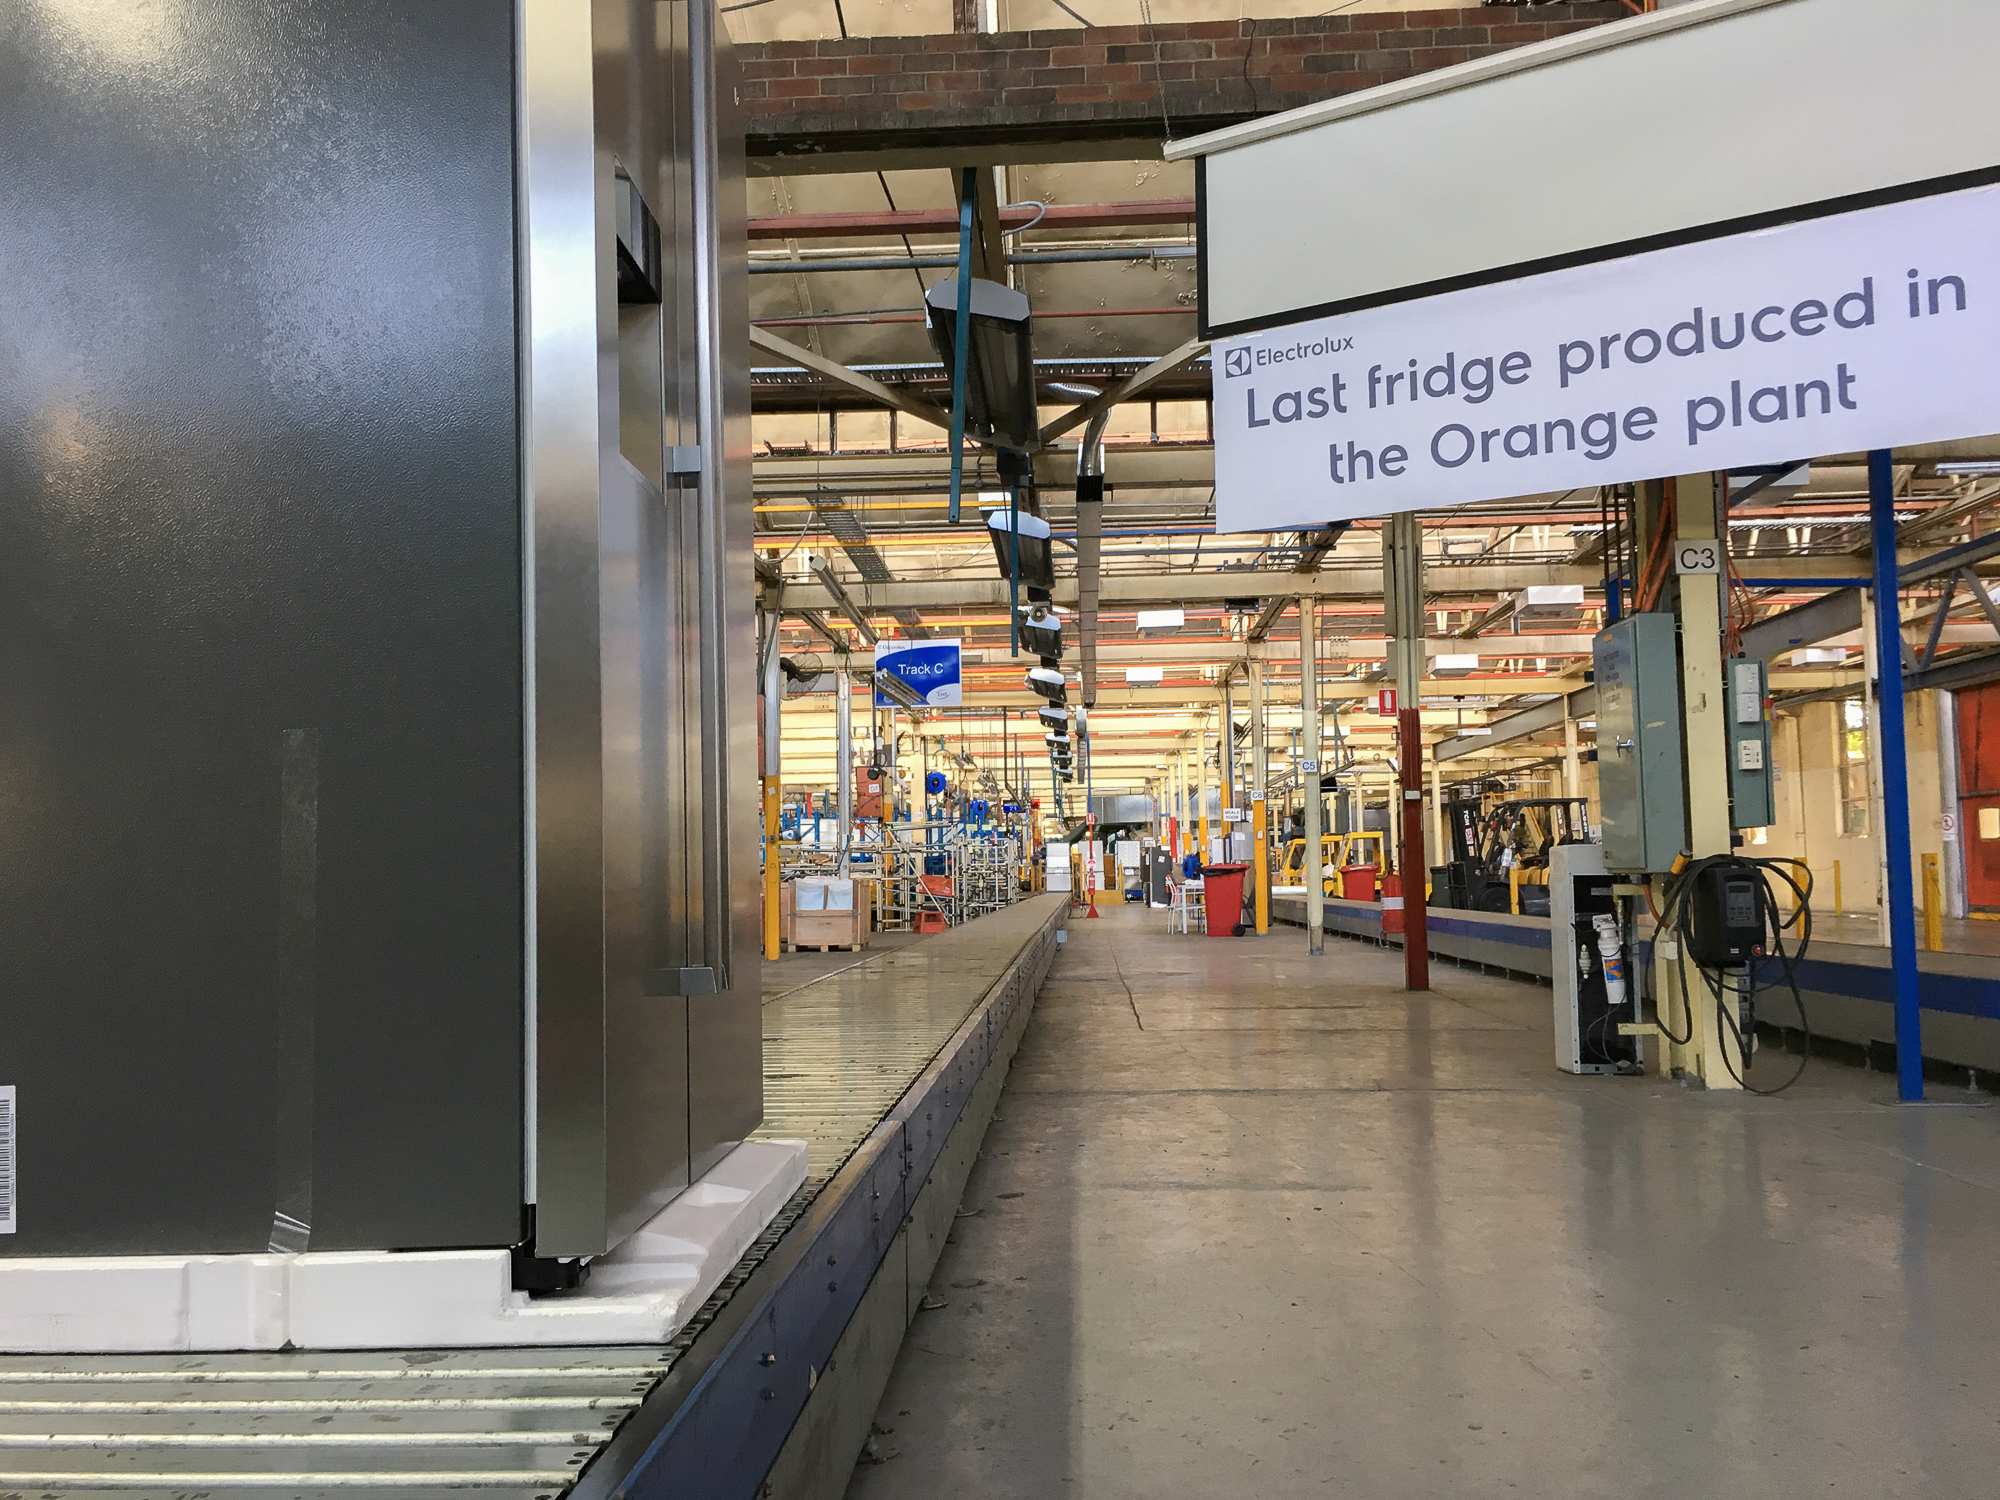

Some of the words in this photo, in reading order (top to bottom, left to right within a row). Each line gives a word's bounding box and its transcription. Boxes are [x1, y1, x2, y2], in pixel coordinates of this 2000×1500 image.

[1247, 372, 1348, 429] Last
[1367, 351, 1532, 410] fridge
[1558, 276, 1875, 389] produced
[1906, 268, 1967, 319] in
[1256, 336, 1355, 367] Electrolux
[1329, 440, 1409, 485] the
[1430, 406, 1658, 469] Orange
[1686, 362, 1858, 446] plant
[1680, 547, 1716, 570] C3
[897, 663, 931, 675] Track
[934, 663, 944, 674] C
[1302, 761, 1316, 771] C5
